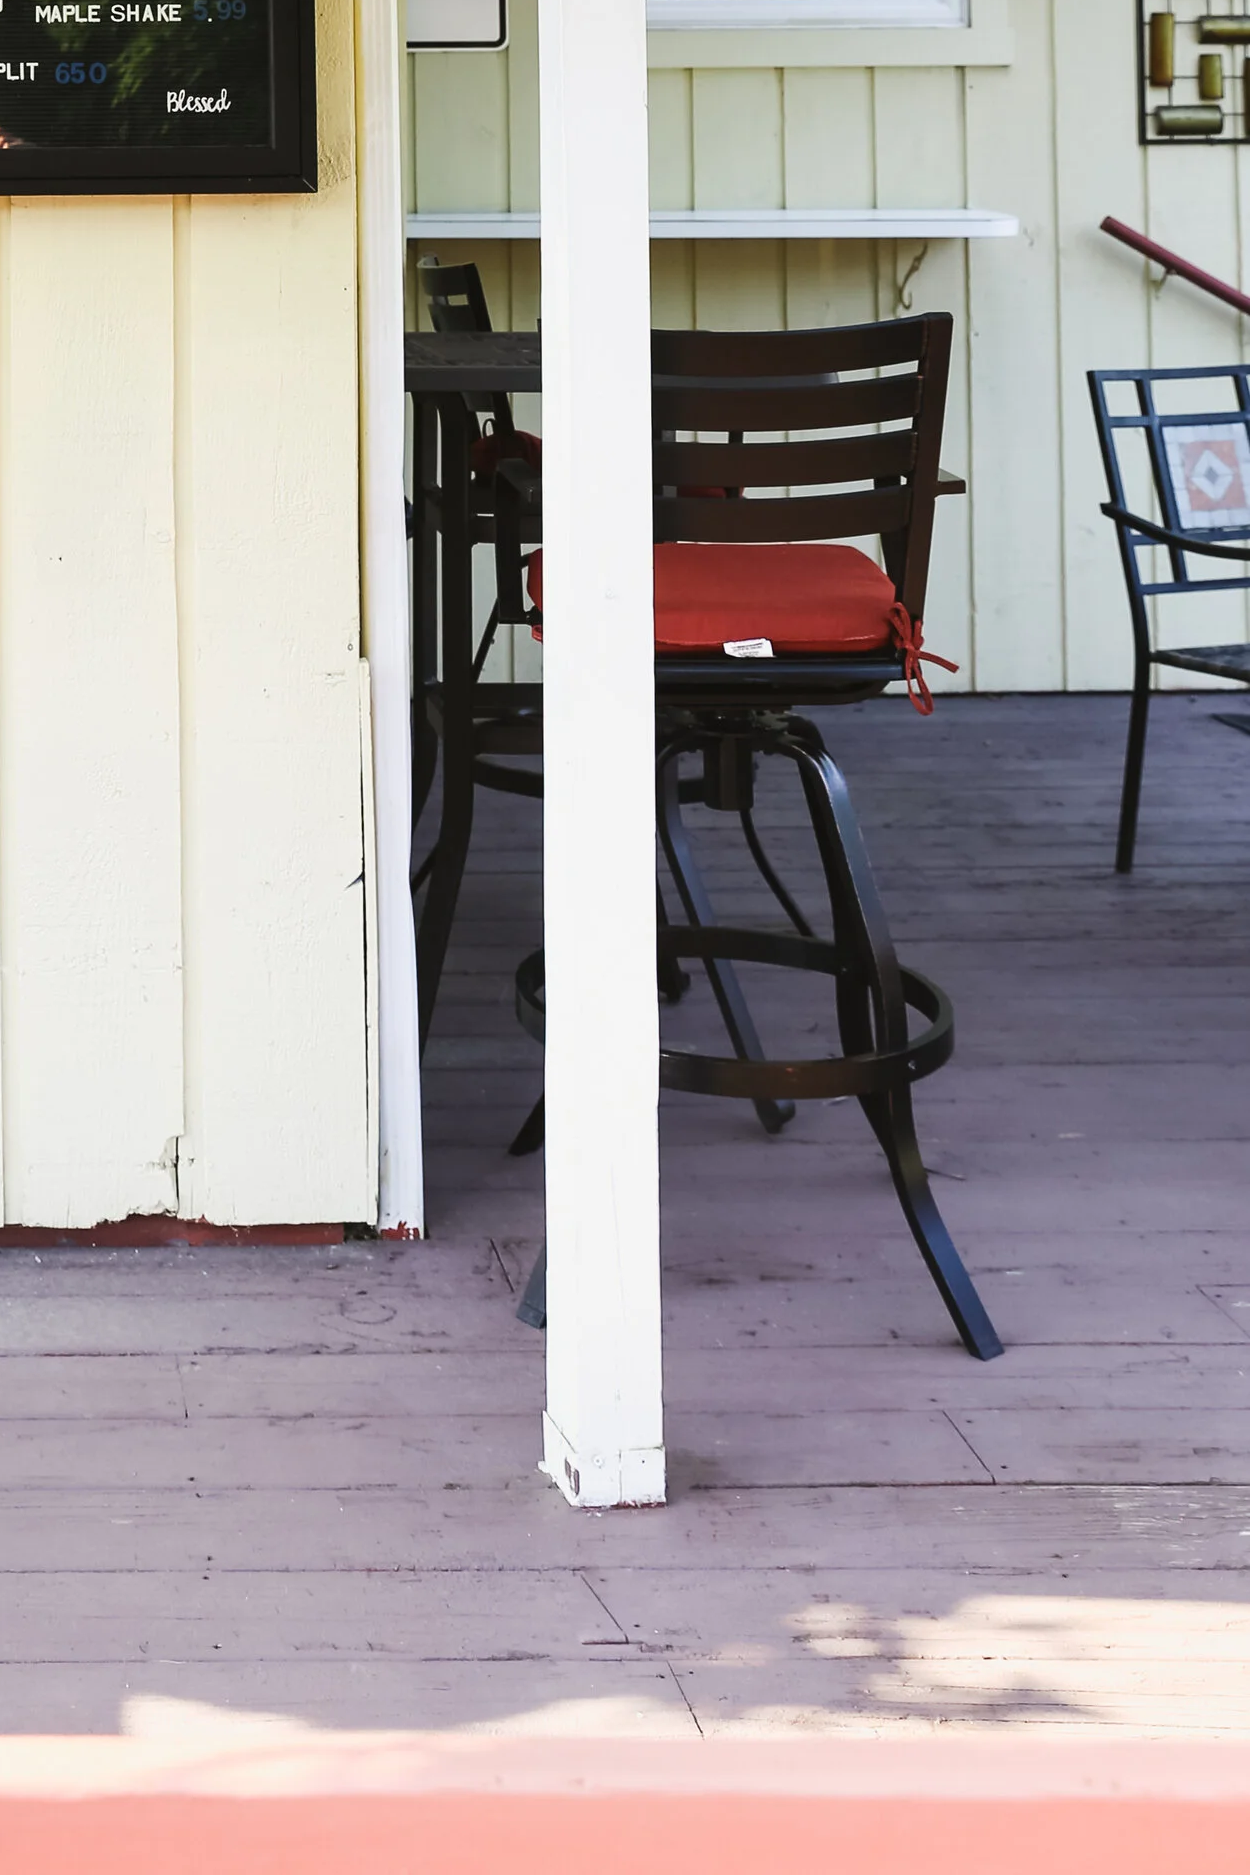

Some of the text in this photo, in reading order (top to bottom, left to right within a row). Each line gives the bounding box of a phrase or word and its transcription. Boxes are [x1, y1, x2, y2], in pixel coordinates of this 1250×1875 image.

[36, 5, 100, 24] MAPLE
[111, 4, 181, 22] SHAKE
[167, 89, 231, 113] Blessed
